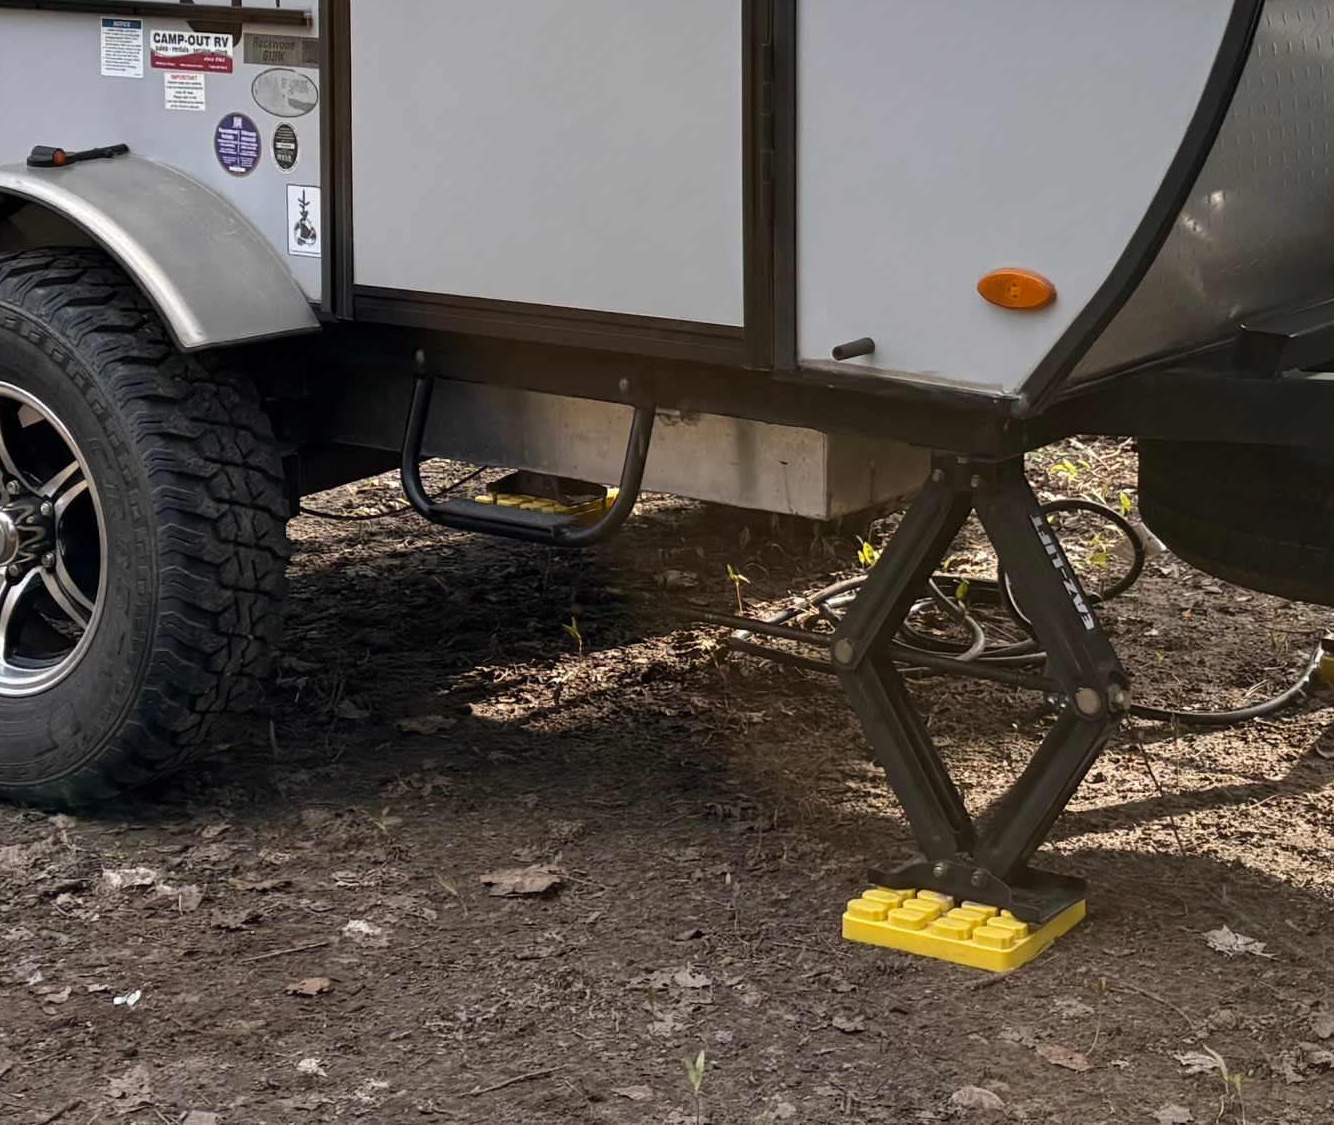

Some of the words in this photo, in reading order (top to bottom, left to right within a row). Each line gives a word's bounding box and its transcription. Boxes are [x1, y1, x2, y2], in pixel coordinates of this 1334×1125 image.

[153, 32, 211, 46] CAMP-OUT
[214, 36, 229, 48] RV
[253, 37, 296, 51] Rockwood
[1029, 514, 1096, 631] EAZ-LIFT
